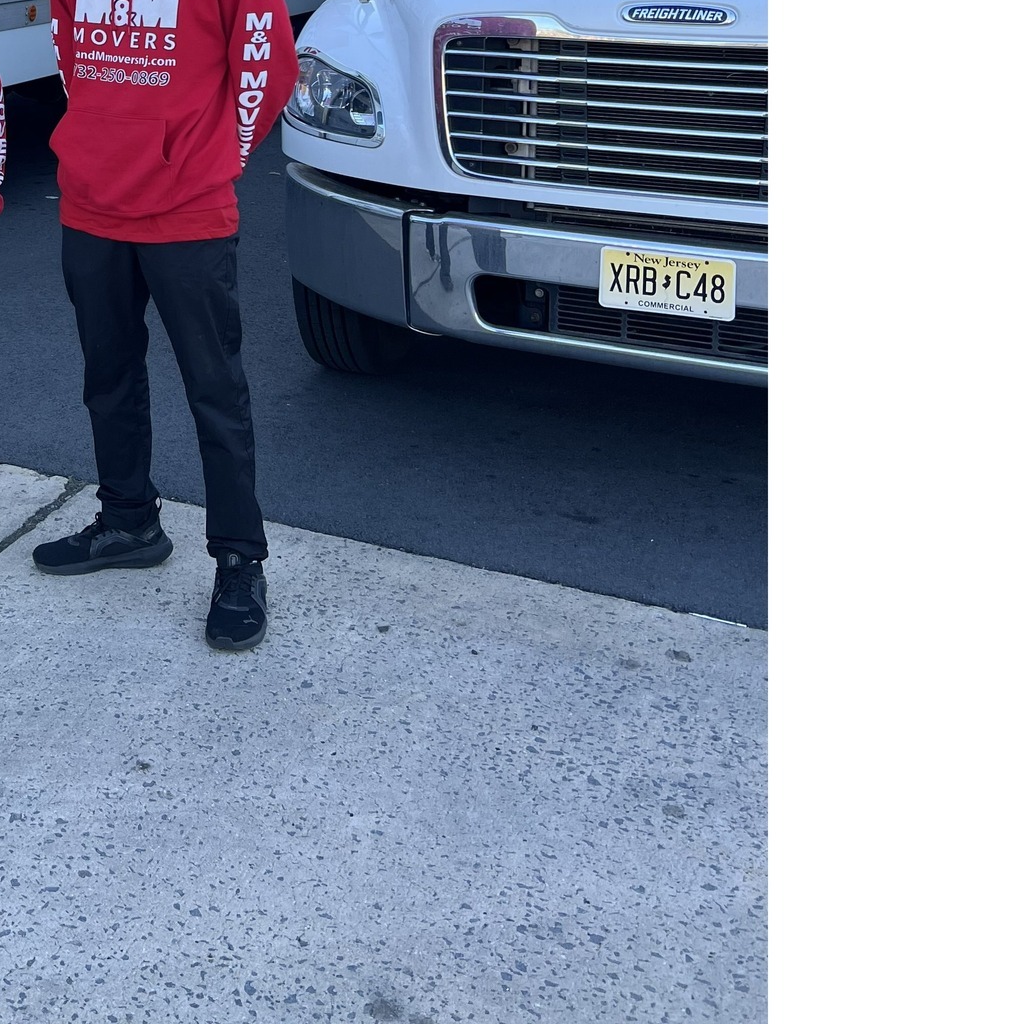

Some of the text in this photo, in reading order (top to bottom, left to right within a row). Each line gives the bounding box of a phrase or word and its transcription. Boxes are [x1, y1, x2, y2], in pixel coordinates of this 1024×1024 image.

[632, 8, 724, 21] FREIGHTLINER
[73, 26, 176, 50] MOVERS
[243, 12, 273, 61] M&M
[75, 50, 176, 67] andMmoversnj.com
[634, 253, 701, 271] New Jersey
[609, 262, 725, 303] XRB C48
[638, 300, 694, 312] COMMERCIAL
